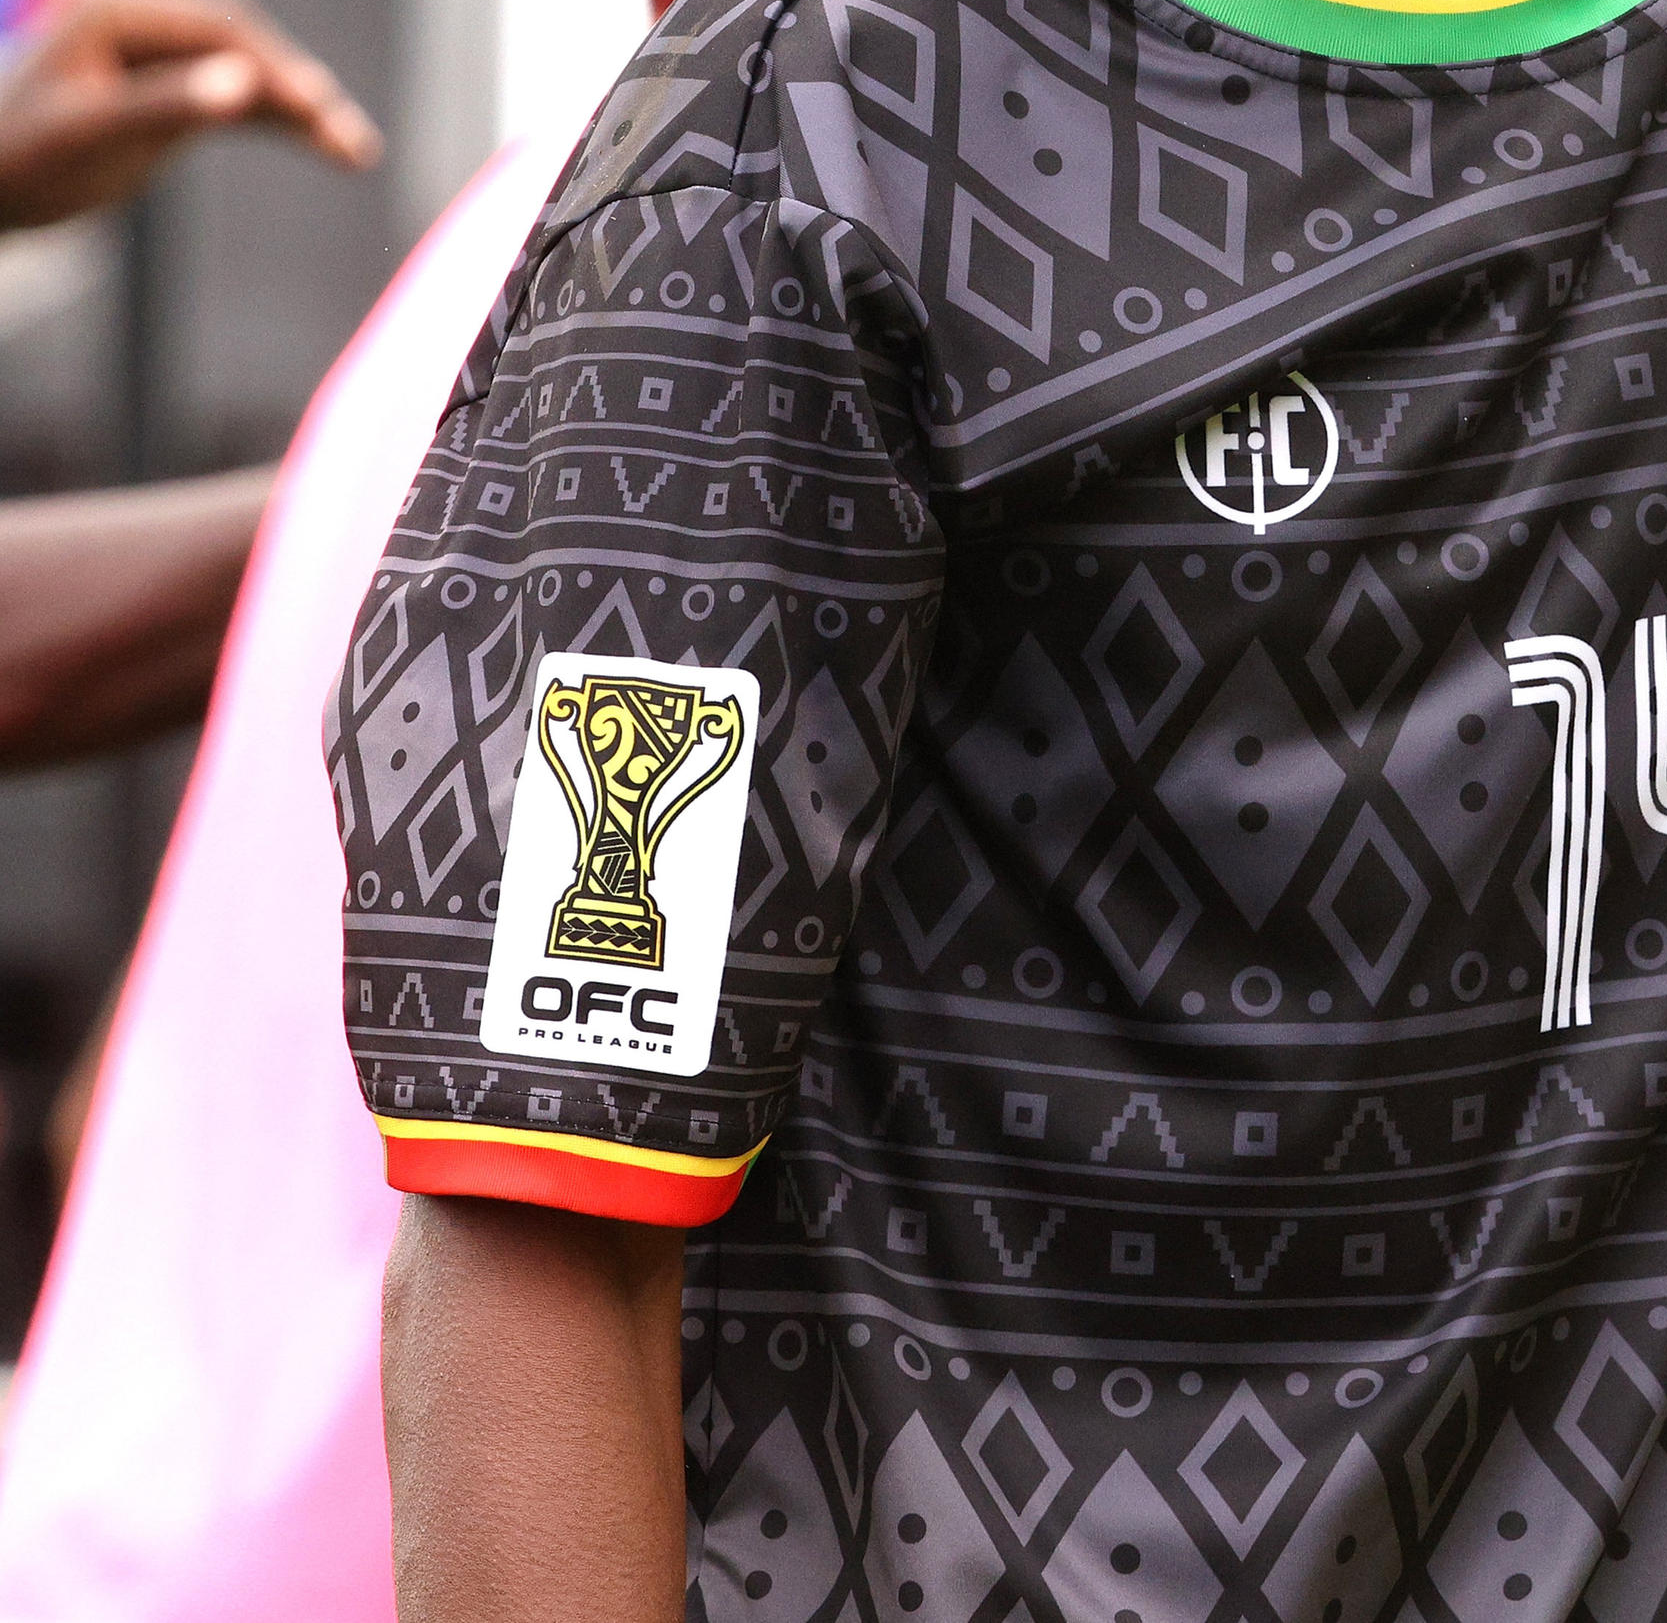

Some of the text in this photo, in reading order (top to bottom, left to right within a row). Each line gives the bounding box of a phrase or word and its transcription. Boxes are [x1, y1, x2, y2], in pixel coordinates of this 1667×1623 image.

[521, 976, 678, 1036] OFC
[518, 1027, 672, 1054] PRO LEAGUE
